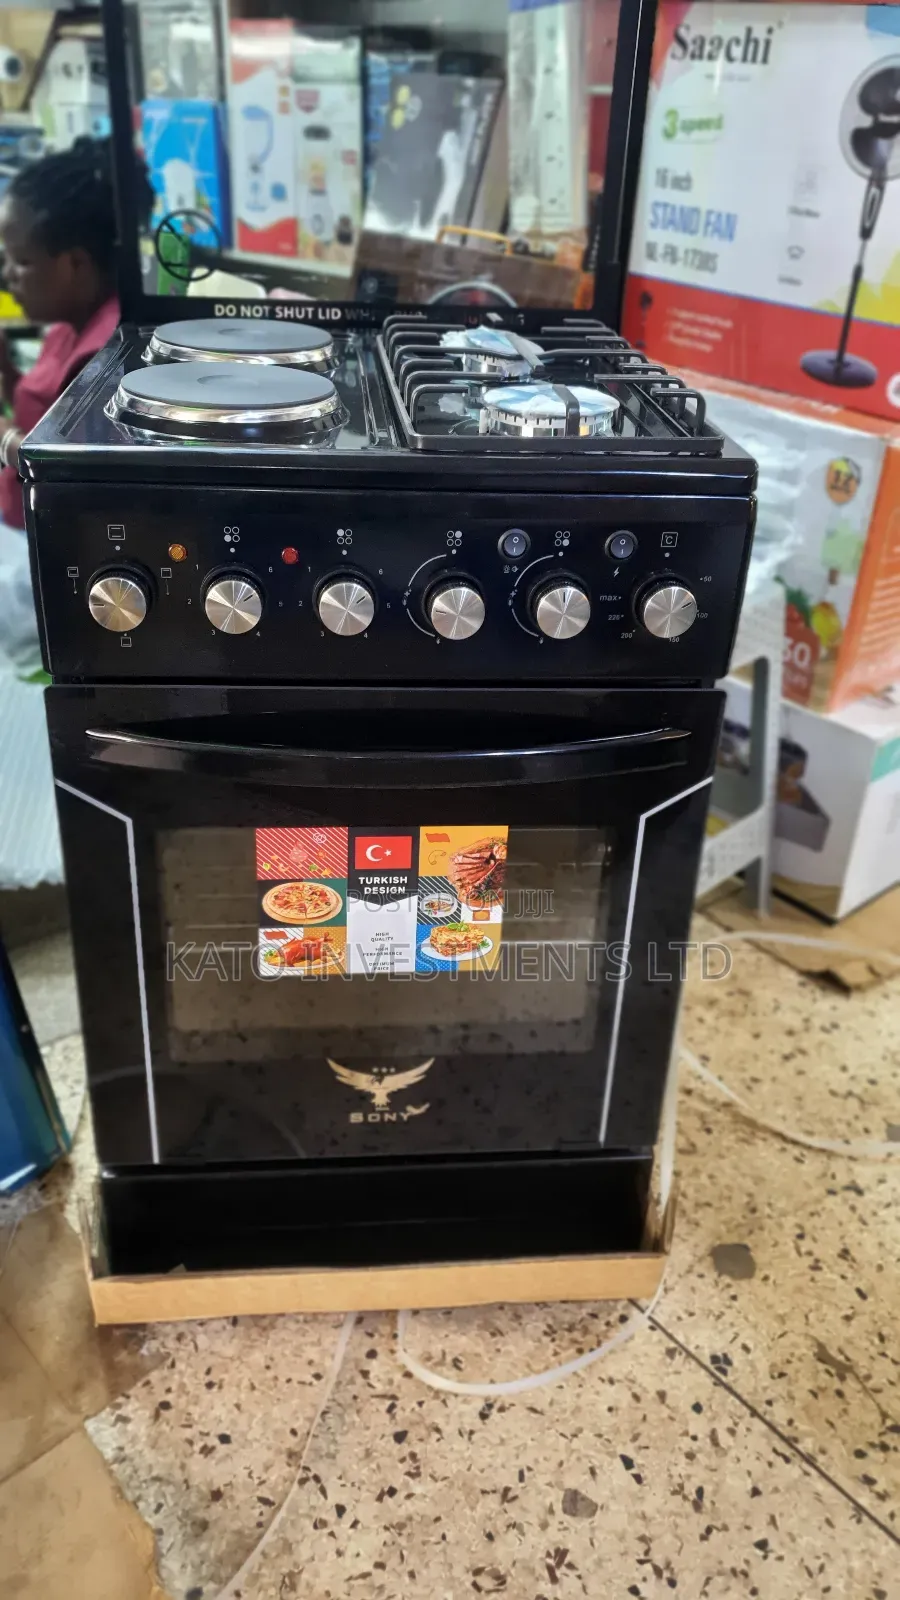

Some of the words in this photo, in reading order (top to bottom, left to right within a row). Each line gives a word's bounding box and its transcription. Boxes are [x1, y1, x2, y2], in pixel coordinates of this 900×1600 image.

[671, 23, 774, 65] Saachi
[662, 108, 679, 140] 3
[649, 200, 701, 236] STAND
[702, 208, 738, 243] FAN
[214, 304, 236, 317] DO
[240, 305, 270, 318] NOT
[275, 306, 314, 319] SHUT
[318, 307, 341, 320] LID
[358, 876, 408, 884] TURKISH
[364, 886, 406, 895] DESIGN
